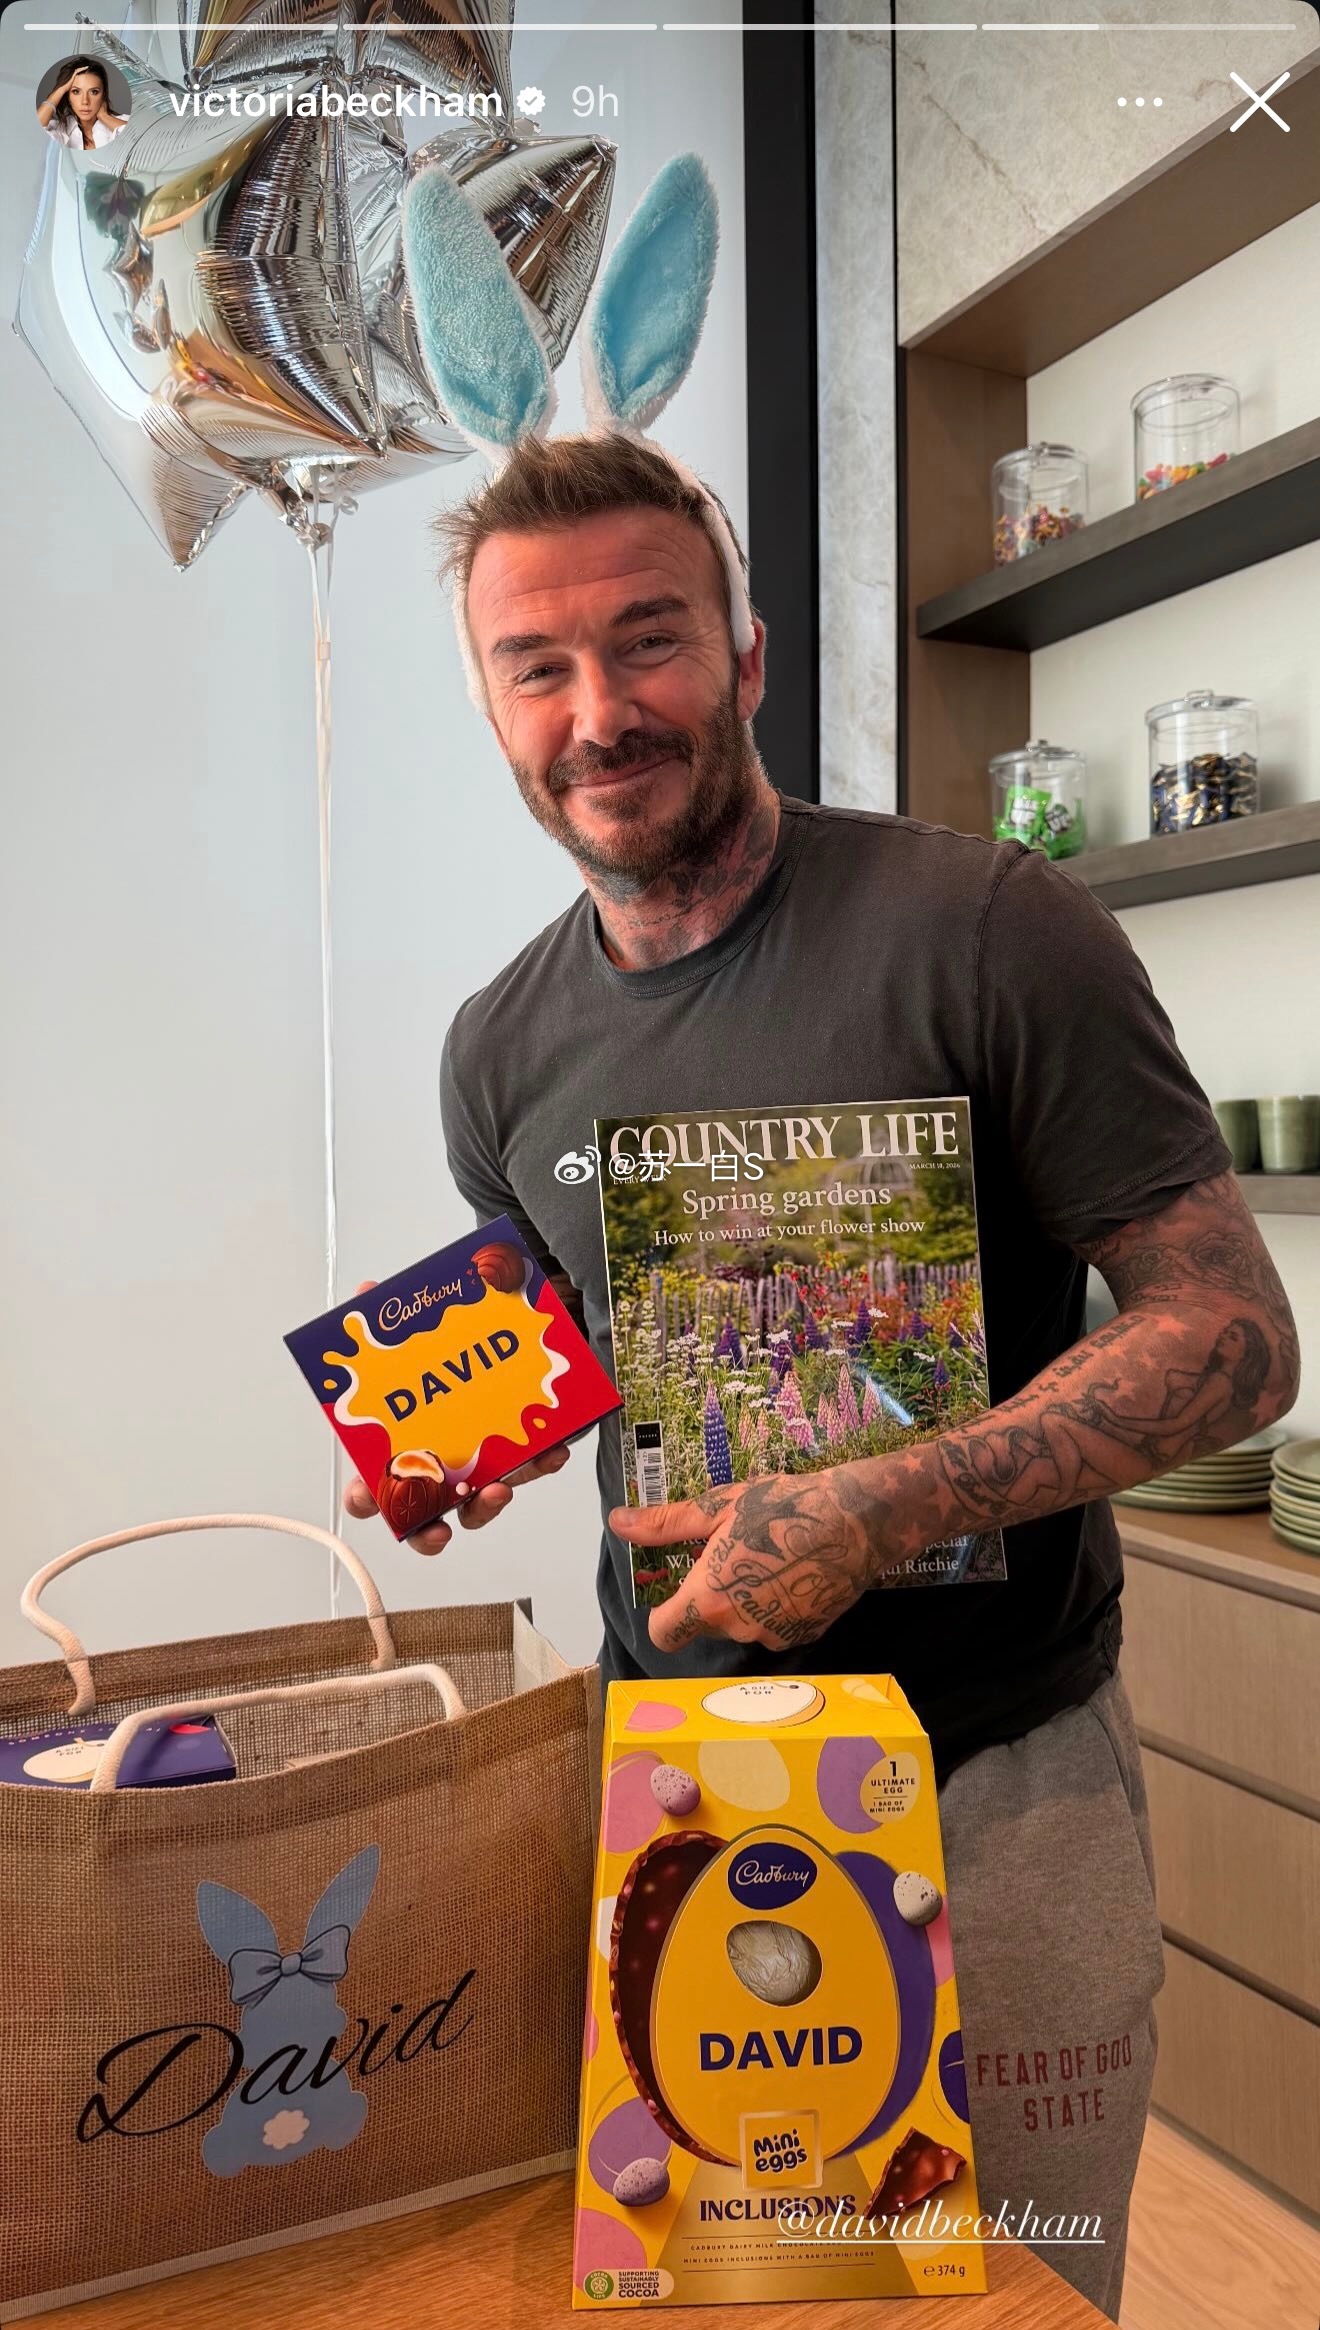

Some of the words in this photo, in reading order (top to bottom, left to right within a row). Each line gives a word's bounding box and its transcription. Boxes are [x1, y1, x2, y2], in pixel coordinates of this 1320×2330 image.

[610, 1114, 842, 1170] COUNTRY
[857, 1111, 960, 1159] LIFE
[682, 1187, 776, 1220] Spring
[783, 1181, 892, 1215] gardens
[654, 1229, 693, 1246] How
[699, 1228, 715, 1241] to
[720, 1224, 752, 1241] win
[757, 1225, 773, 1238] at
[777, 1222, 816, 1240] your
[820, 1219, 875, 1235] flower
[880, 1217, 926, 1233] show
[378, 1278, 463, 1331] Cadbury
[384, 1329, 520, 1422] DAVID
[905, 1556, 959, 1574] Ritchie
[871, 1778, 915, 1786] ULTIMATE
[889, 1761, 897, 1777] 1
[735, 1860, 811, 1886] Cadbury
[76, 1968, 477, 2143] David
[699, 2026, 863, 2071] DAVID
[977, 2051, 1049, 2086] FEAR
[1059, 2046, 1087, 2081] OF
[1097, 2034, 1132, 2075] GOD
[1024, 2088, 1105, 2132] STATE
[755, 2148, 807, 2173] eggs
[700, 2194, 857, 2221] INCLUSIONS
[937, 2264, 956, 2276] 374
[958, 2265, 965, 2278] g
[618, 2289, 659, 2298] COCOA
